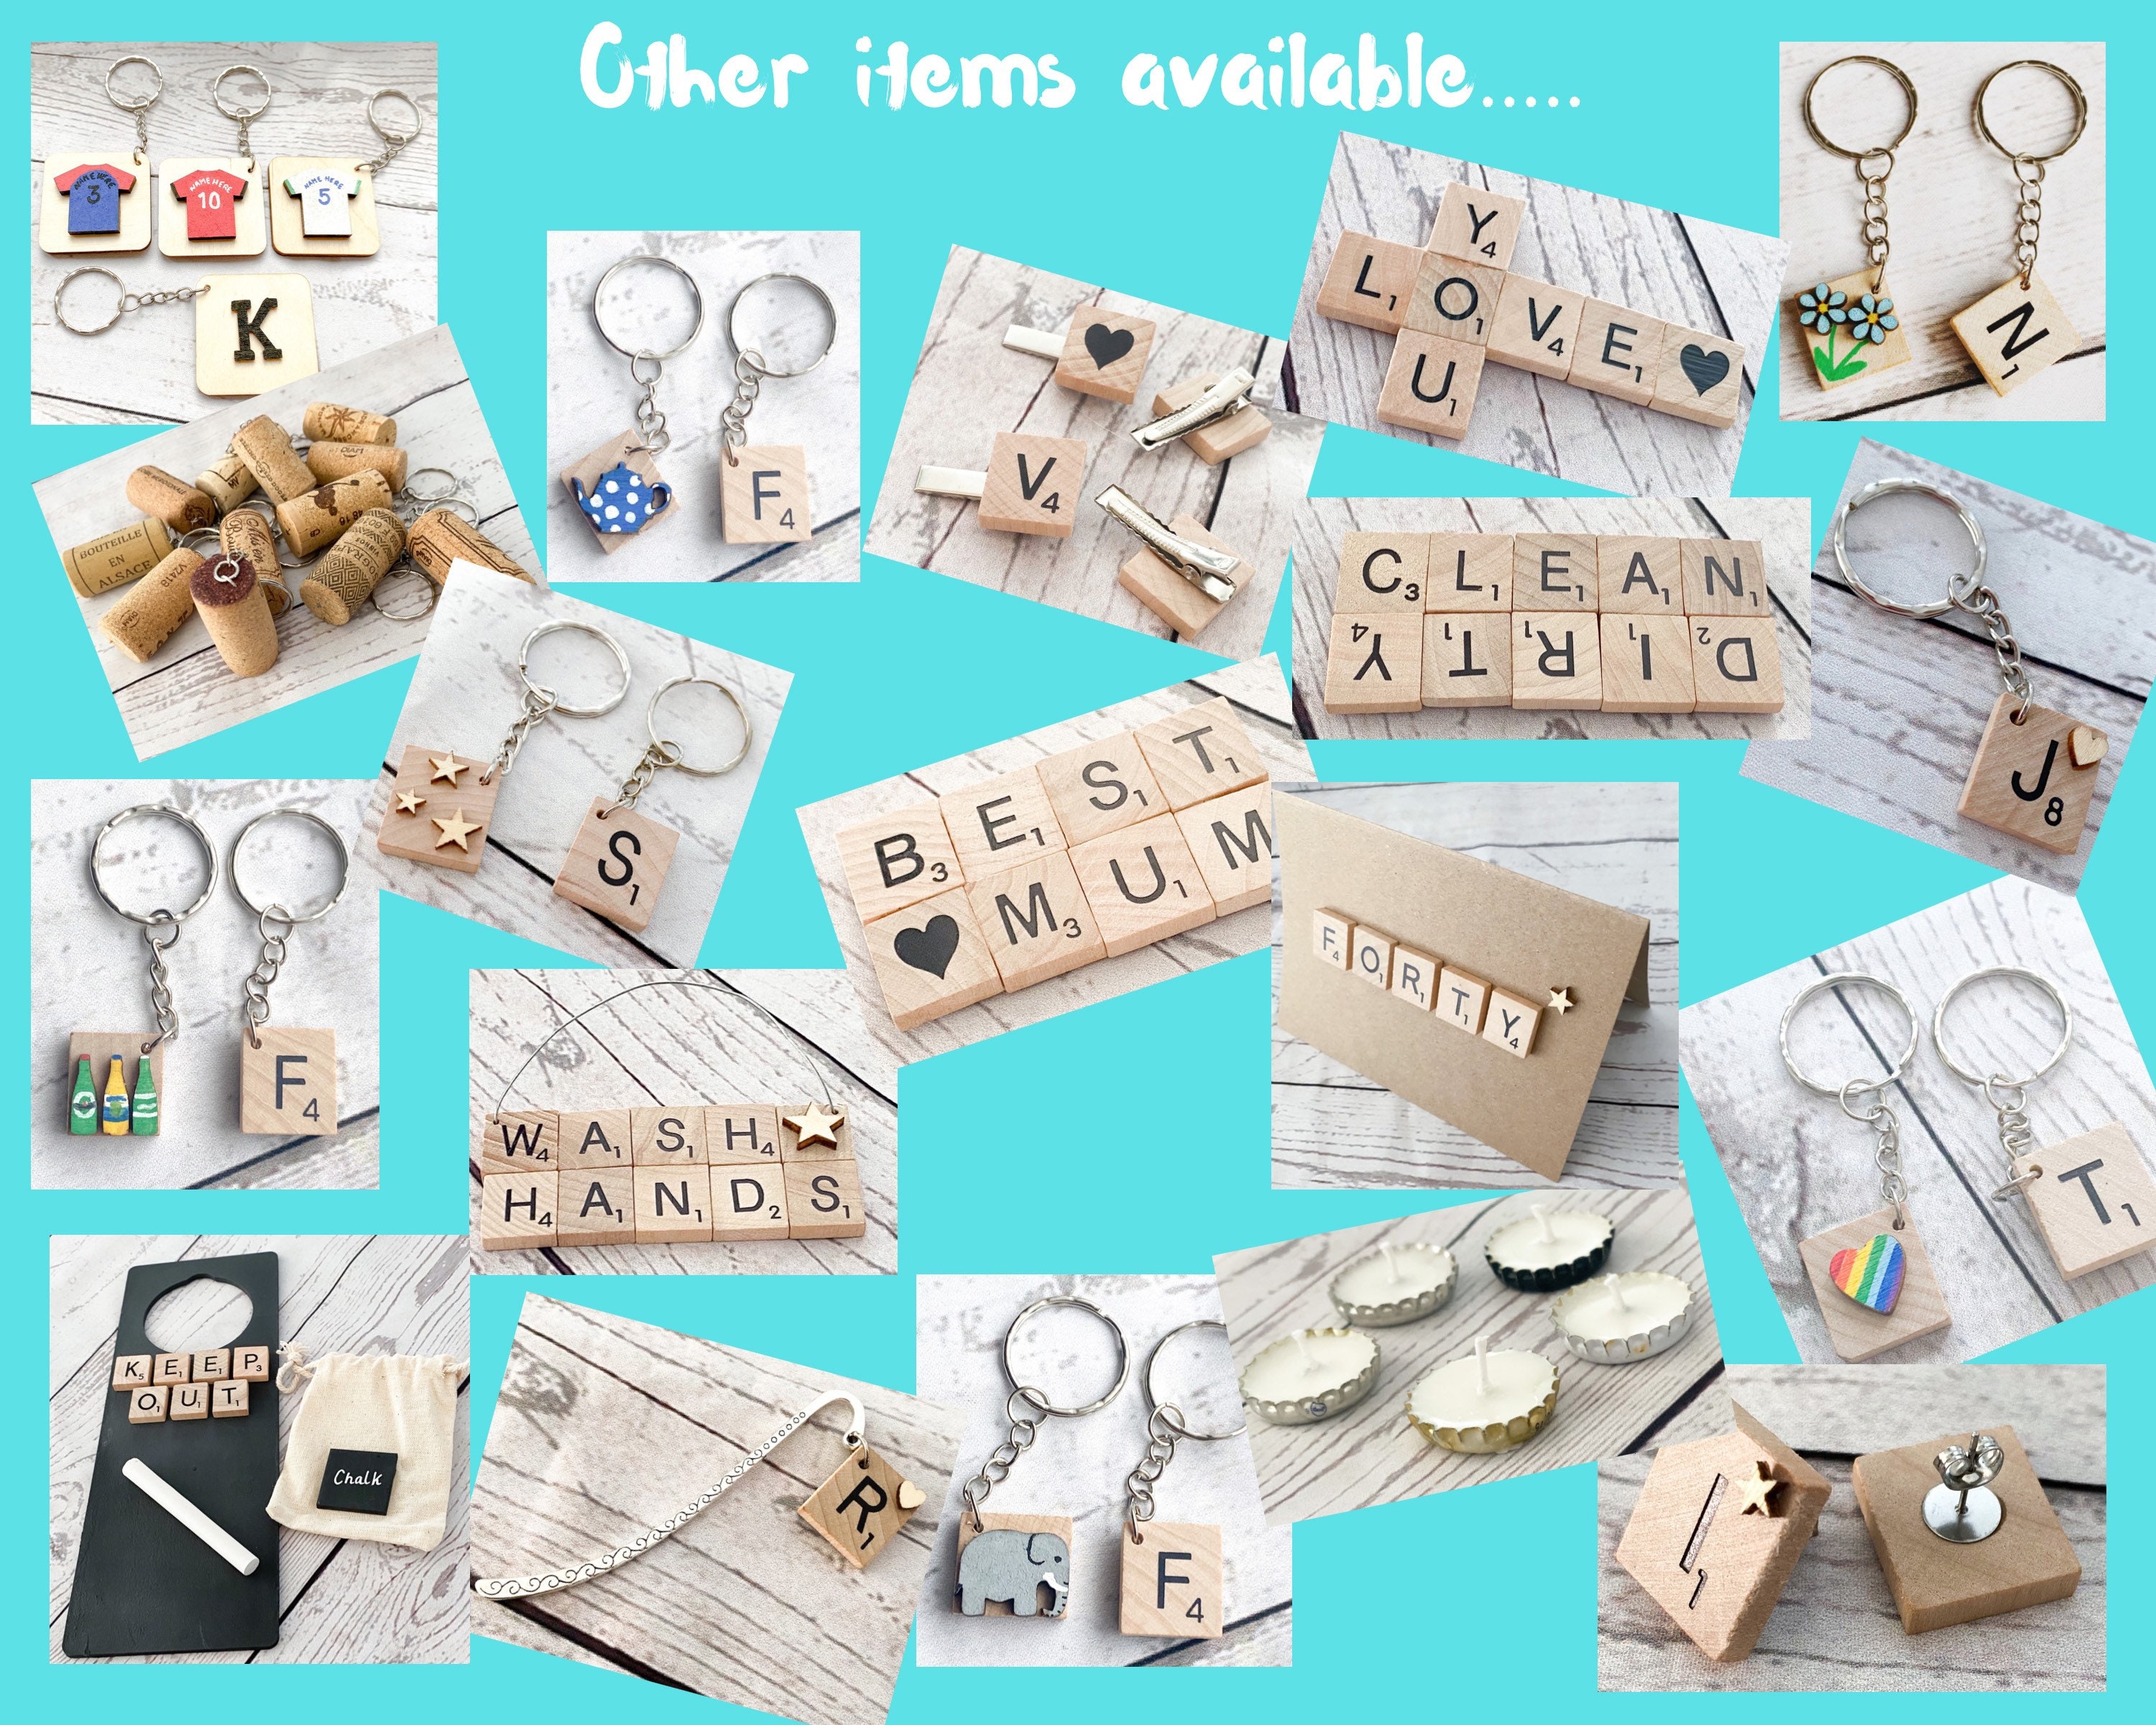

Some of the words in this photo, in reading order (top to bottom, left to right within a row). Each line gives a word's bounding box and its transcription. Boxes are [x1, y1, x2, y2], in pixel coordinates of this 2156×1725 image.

[74, 172, 96, 190] NAME
[87, 185, 101, 204] 3
[190, 177, 210, 192] NAME
[212, 179, 233, 193] HERE
[198, 191, 221, 209] 10
[304, 176, 322, 189] NAME
[325, 176, 344, 190] HERE
[318, 188, 331, 205] 5
[231, 297, 282, 362] K
[1986, 301, 2050, 361] N
[752, 471, 780, 520] F
[1018, 454, 1056, 500] V
[80, 529, 142, 559] BOUTEILLE
[108, 554, 125, 568] EN
[99, 560, 153, 589] ALSACE
[2012, 740, 2059, 801] J
[598, 831, 640, 886] S
[276, 1055, 308, 1109] F
[2058, 1159, 2111, 1225] T
[333, 1468, 382, 1486] Chalk
[836, 1476, 887, 1534] R
[1157, 1552, 1192, 1609] F
